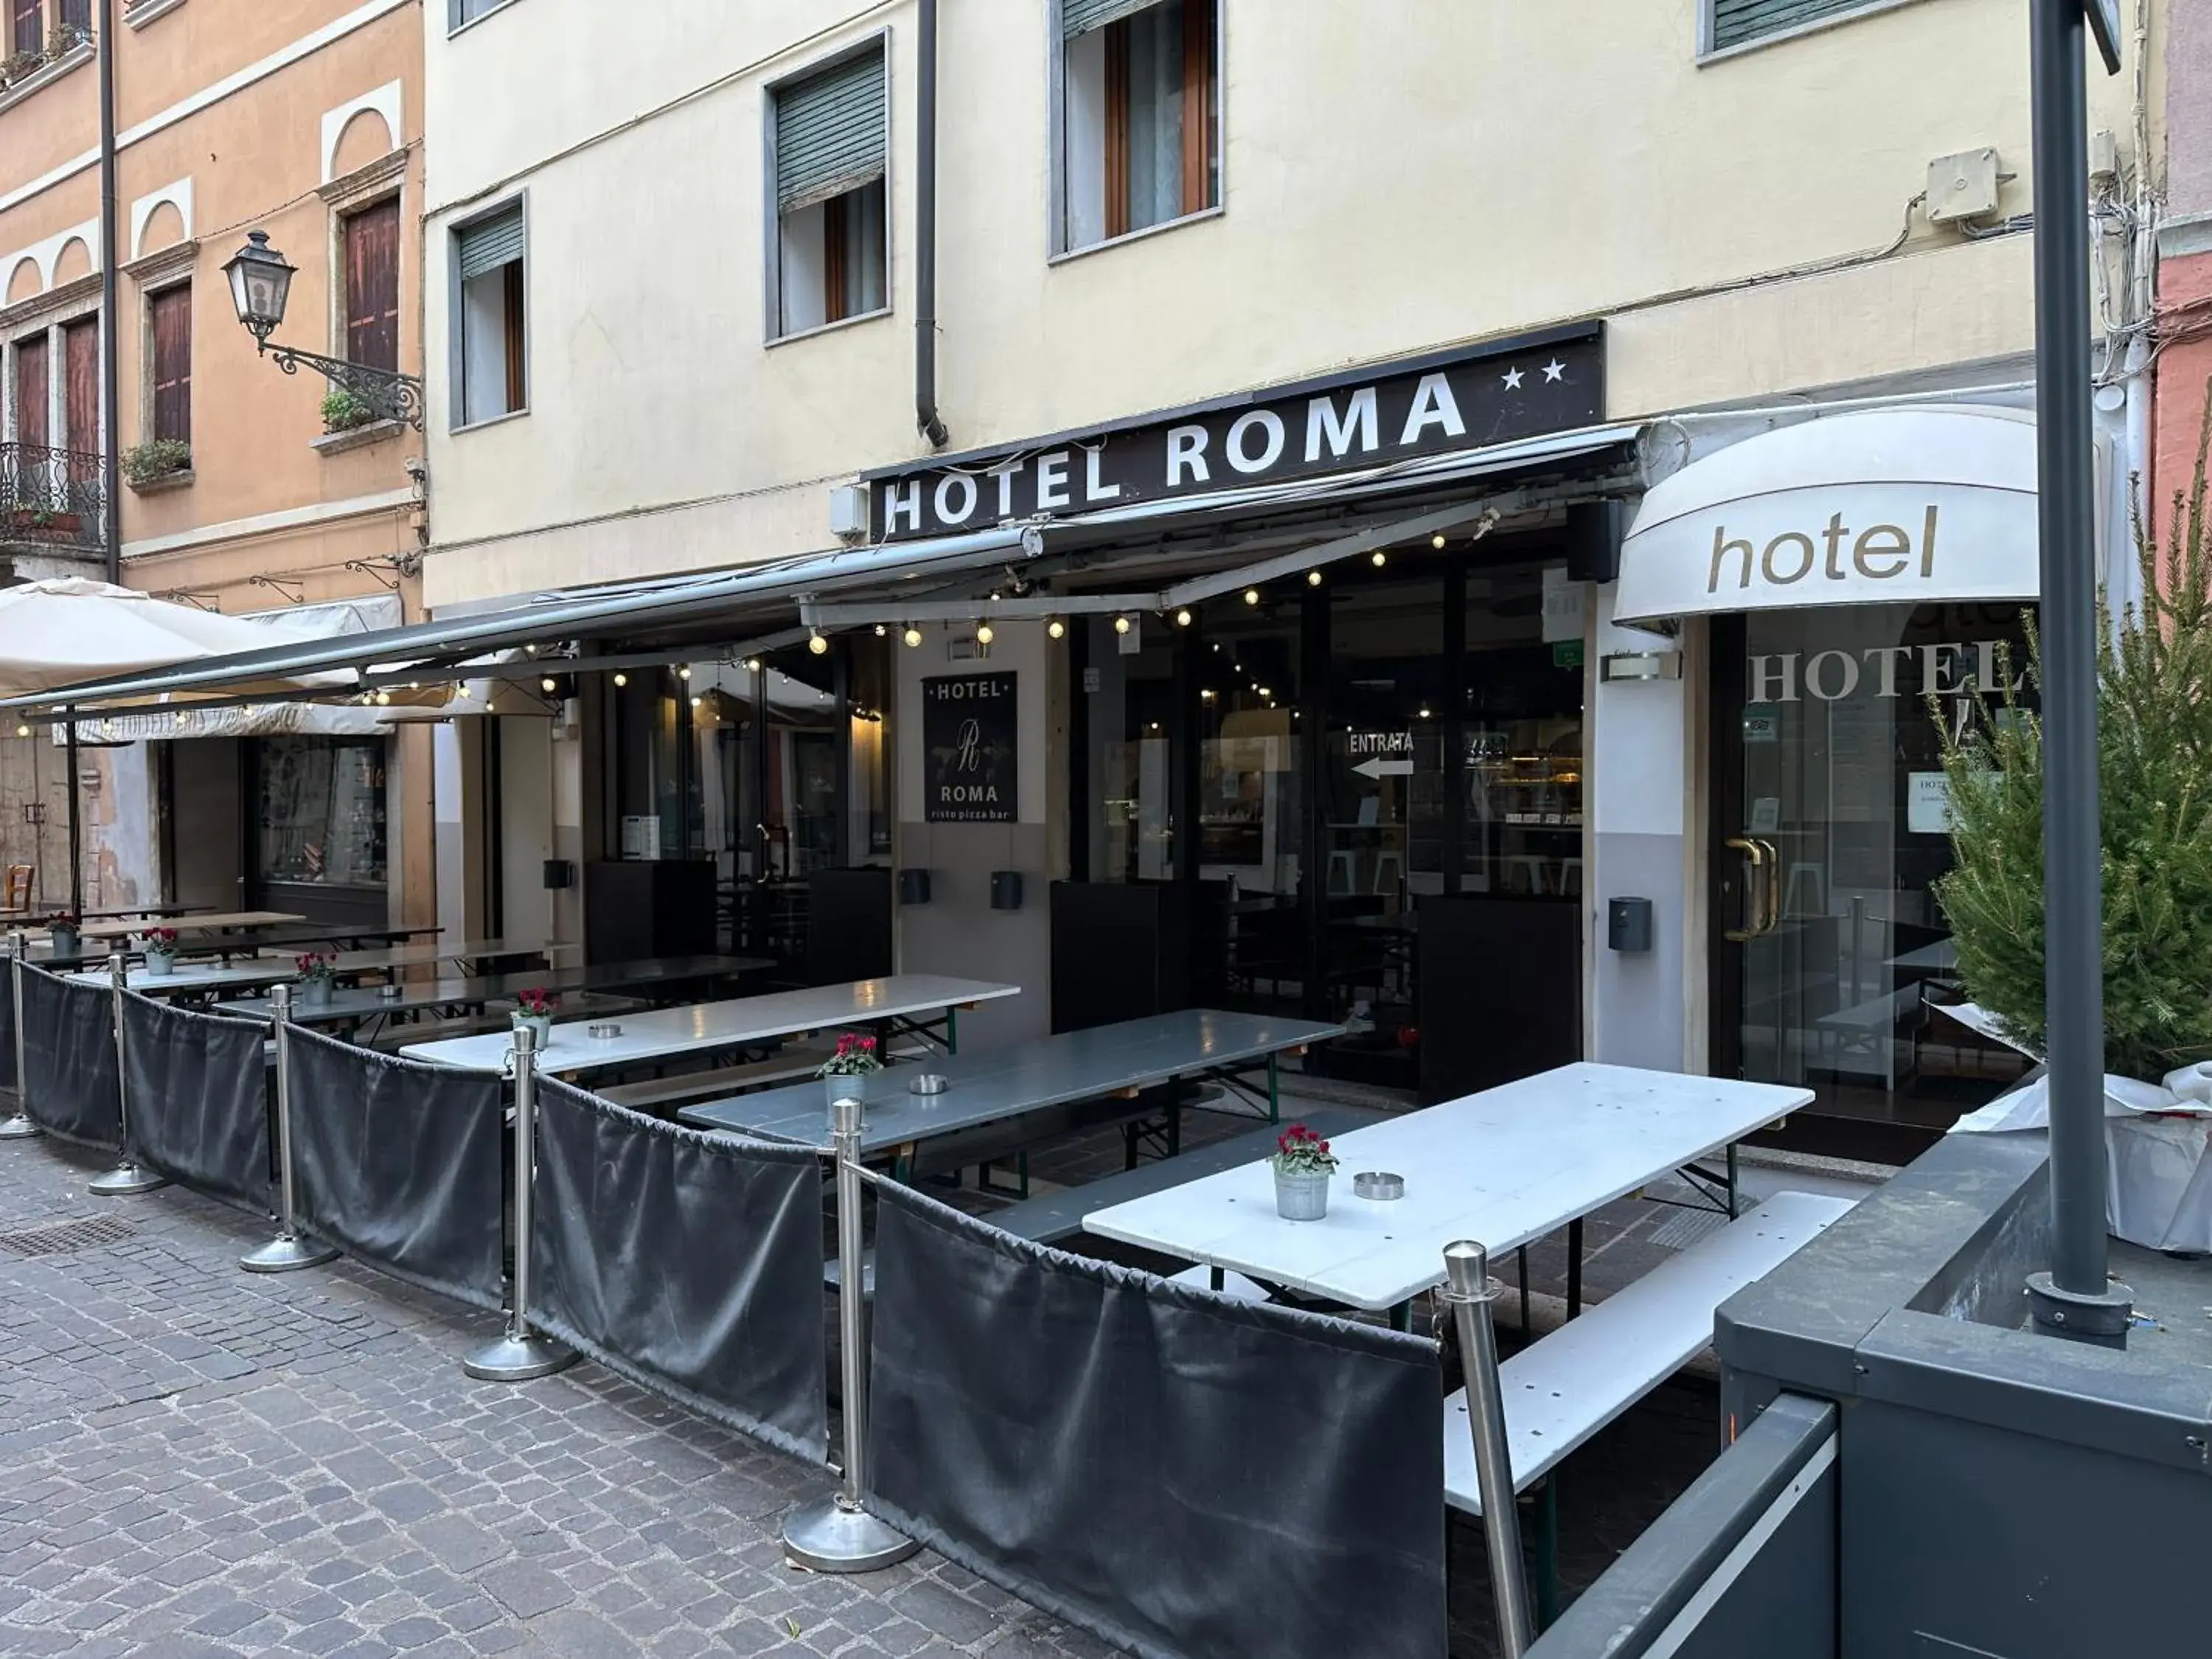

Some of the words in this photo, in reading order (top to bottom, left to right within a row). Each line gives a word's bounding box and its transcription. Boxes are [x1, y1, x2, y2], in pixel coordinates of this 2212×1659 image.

[885, 445, 1120, 534] HOTEL
[1166, 372, 1467, 487] ROMA
[1707, 505, 1938, 593] hotel
[1748, 640, 2023, 703] HOTEL
[937, 681, 1001, 700] HOTEL
[1350, 732, 1413, 752] ENTRATA
[941, 785, 998, 801] ROMA
[959, 808, 987, 820] pizza
[989, 809, 1009, 818] bar
